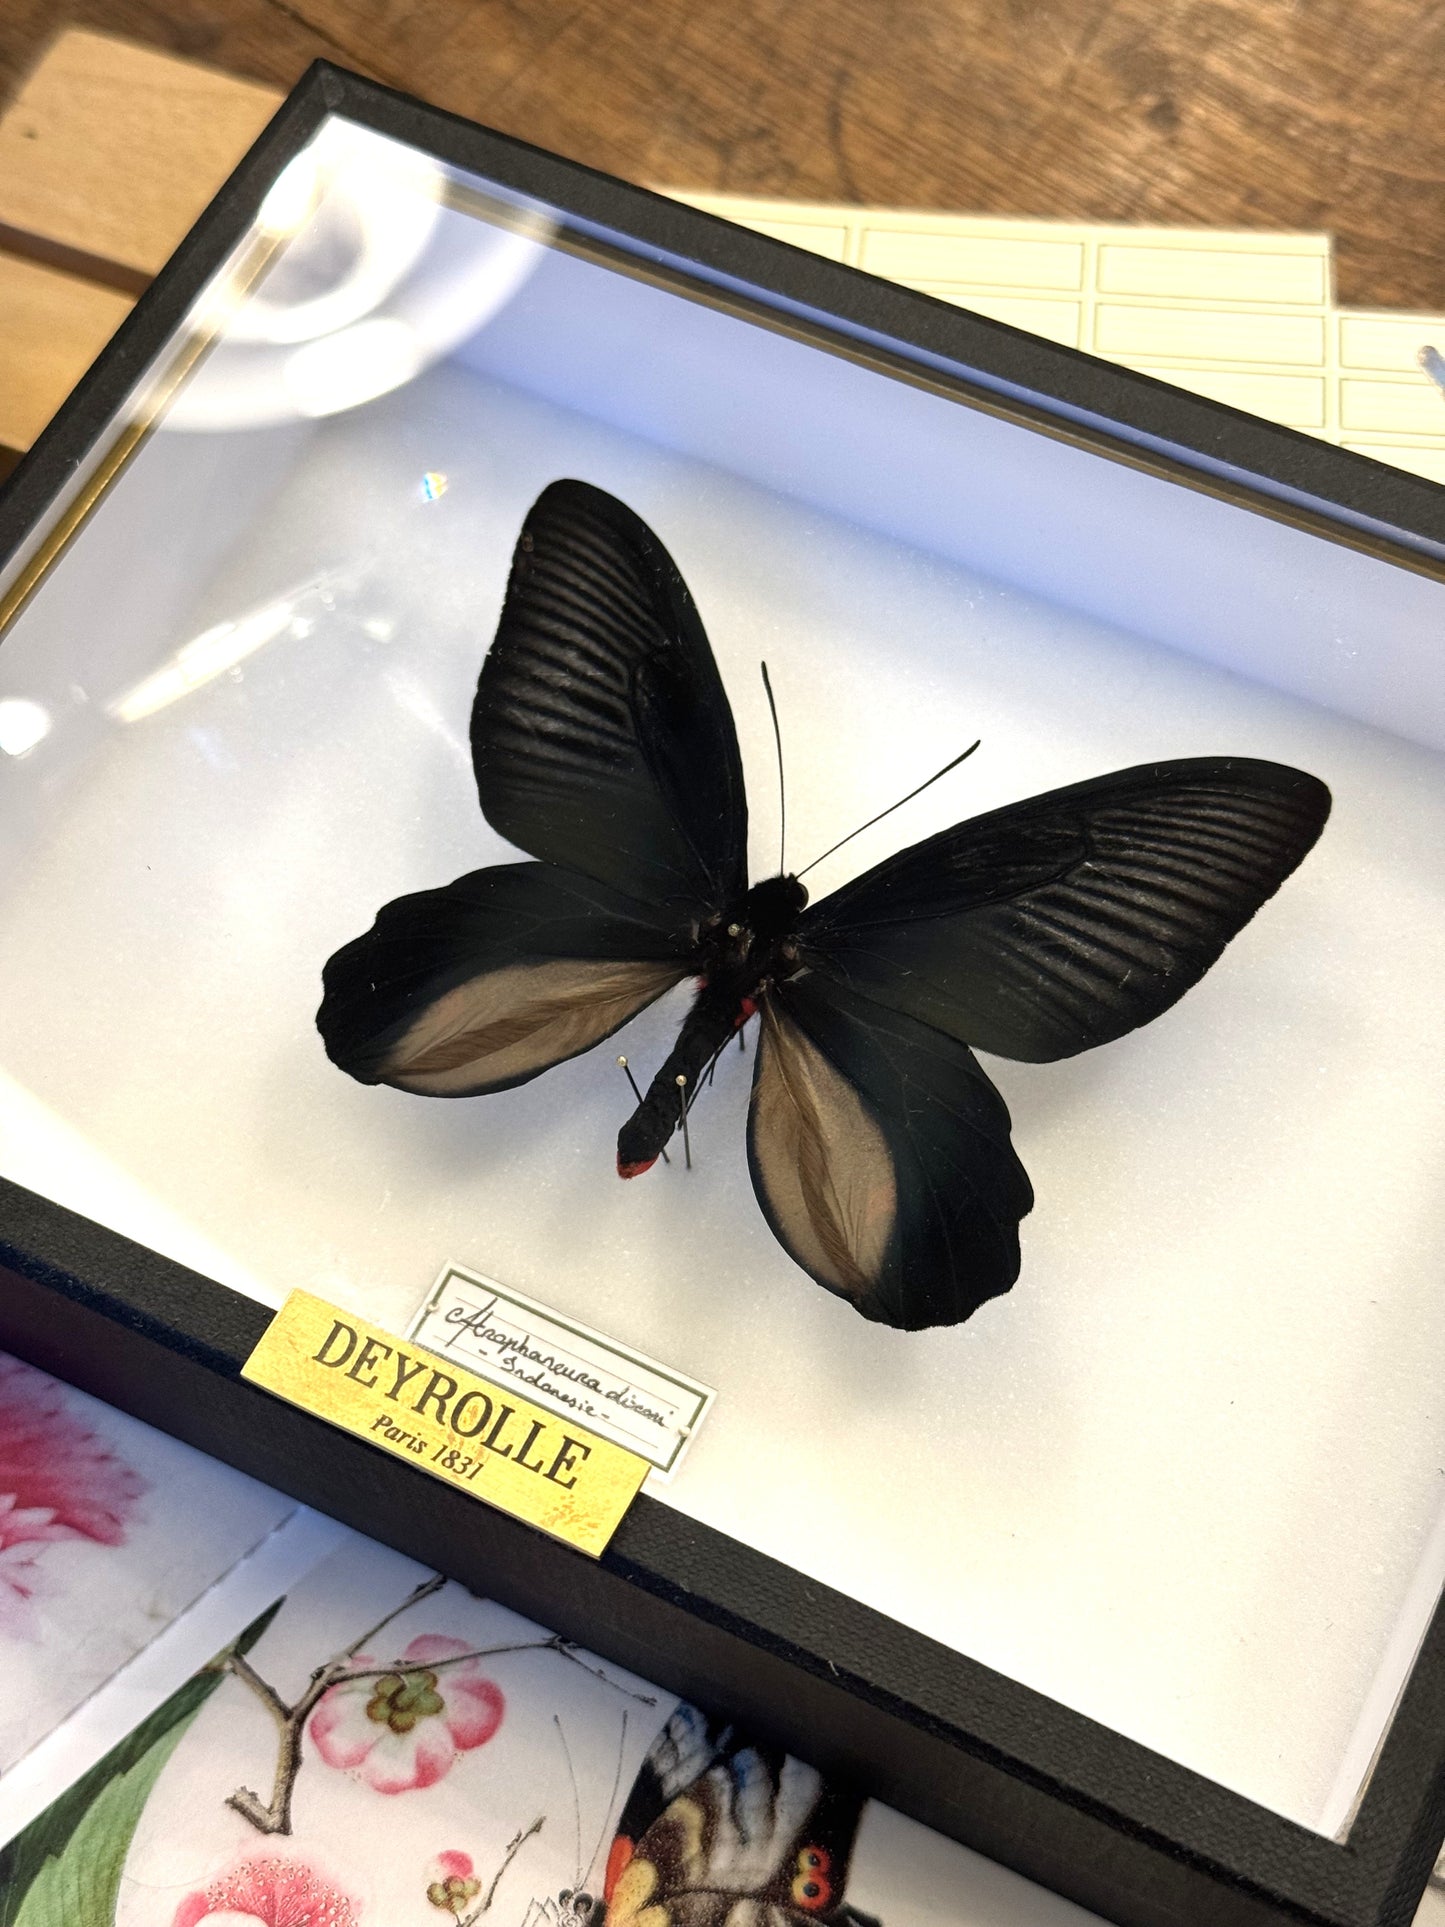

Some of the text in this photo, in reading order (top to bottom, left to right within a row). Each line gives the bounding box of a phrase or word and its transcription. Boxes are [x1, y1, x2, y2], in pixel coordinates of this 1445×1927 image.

[311, 1318, 592, 1490] DEYROLLE
[370, 1413, 486, 1481] Paris 1831
